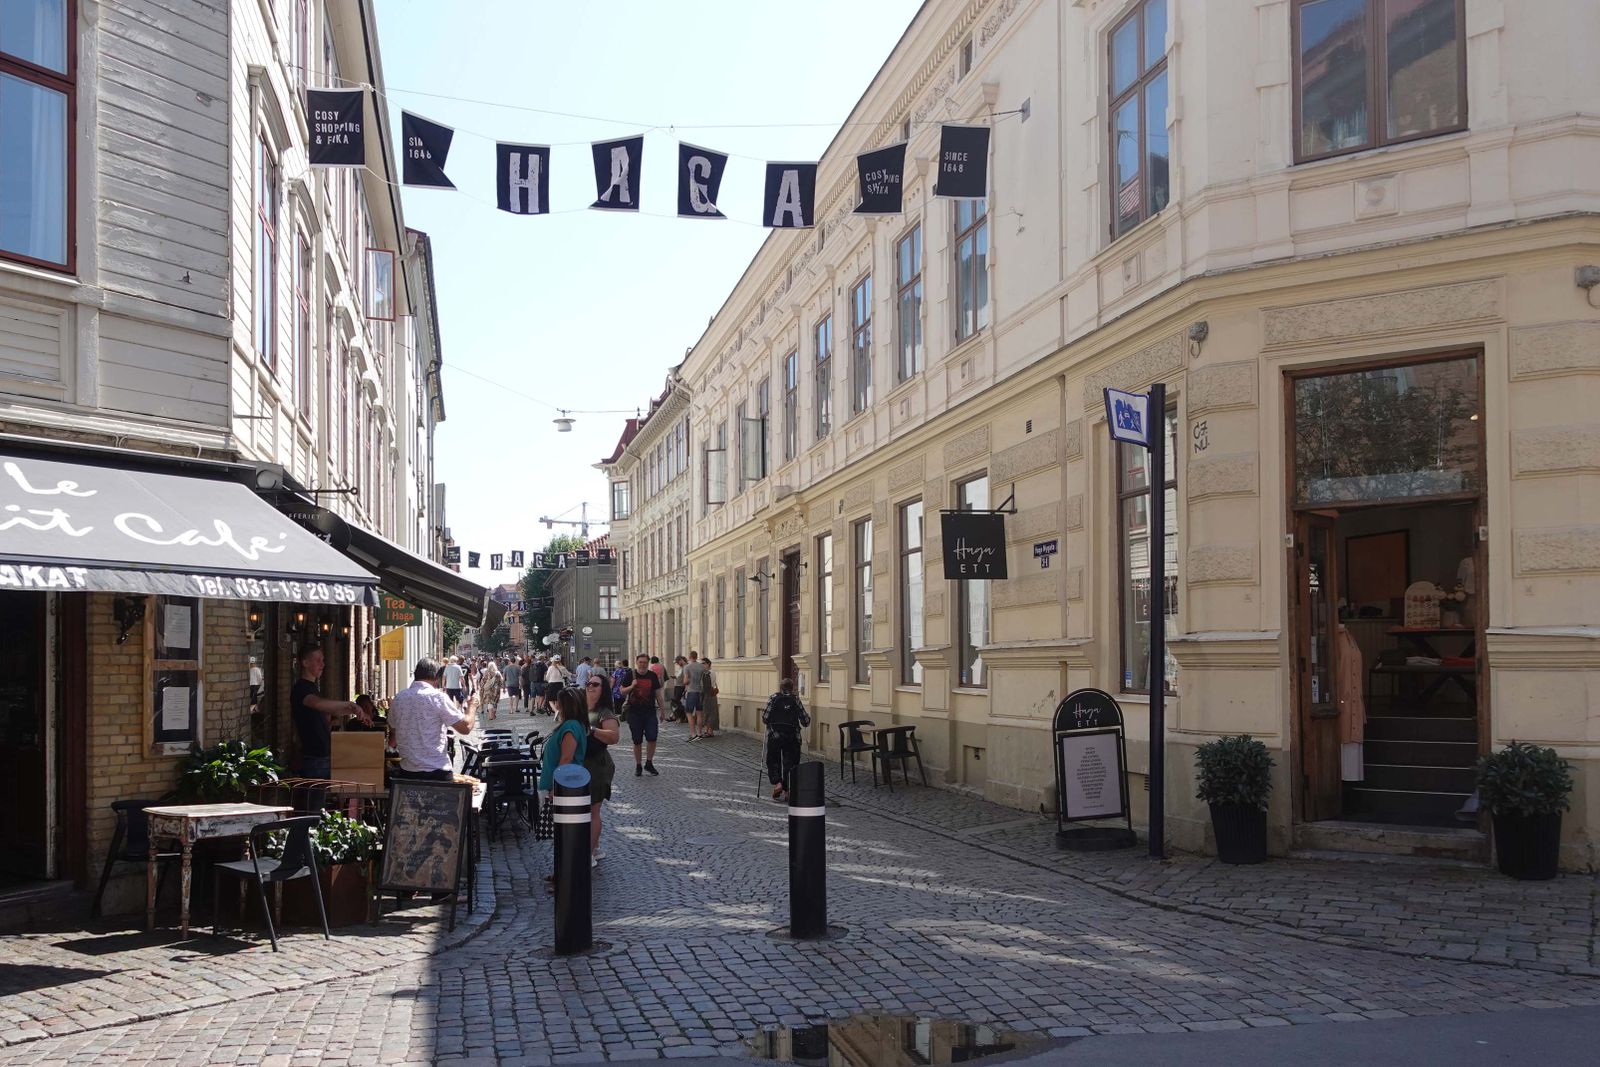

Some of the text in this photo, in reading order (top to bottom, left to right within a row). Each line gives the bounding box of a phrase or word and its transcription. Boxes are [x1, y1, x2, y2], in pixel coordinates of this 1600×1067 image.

[315, 110, 339, 121] COSY
[315, 122, 361, 133] SHOPPING
[315, 134, 349, 145] & FIKA
[408, 149, 432, 160] 1648
[944, 151, 968, 162] SINCE
[943, 162, 964, 174] 1648
[865, 168, 887, 182] COSY
[4, 462, 97, 497] Le
[113, 512, 287, 561] Café
[953, 537, 996, 563] Haga
[960, 563, 991, 574] ETT
[192, 575, 231, 596] Tel.
[306, 582, 329, 600] 20
[384, 597, 405, 609] Tea
[392, 611, 414, 622] Haga
[1072, 702, 1102, 719] Haga
[1077, 719, 1098, 728] ETT
